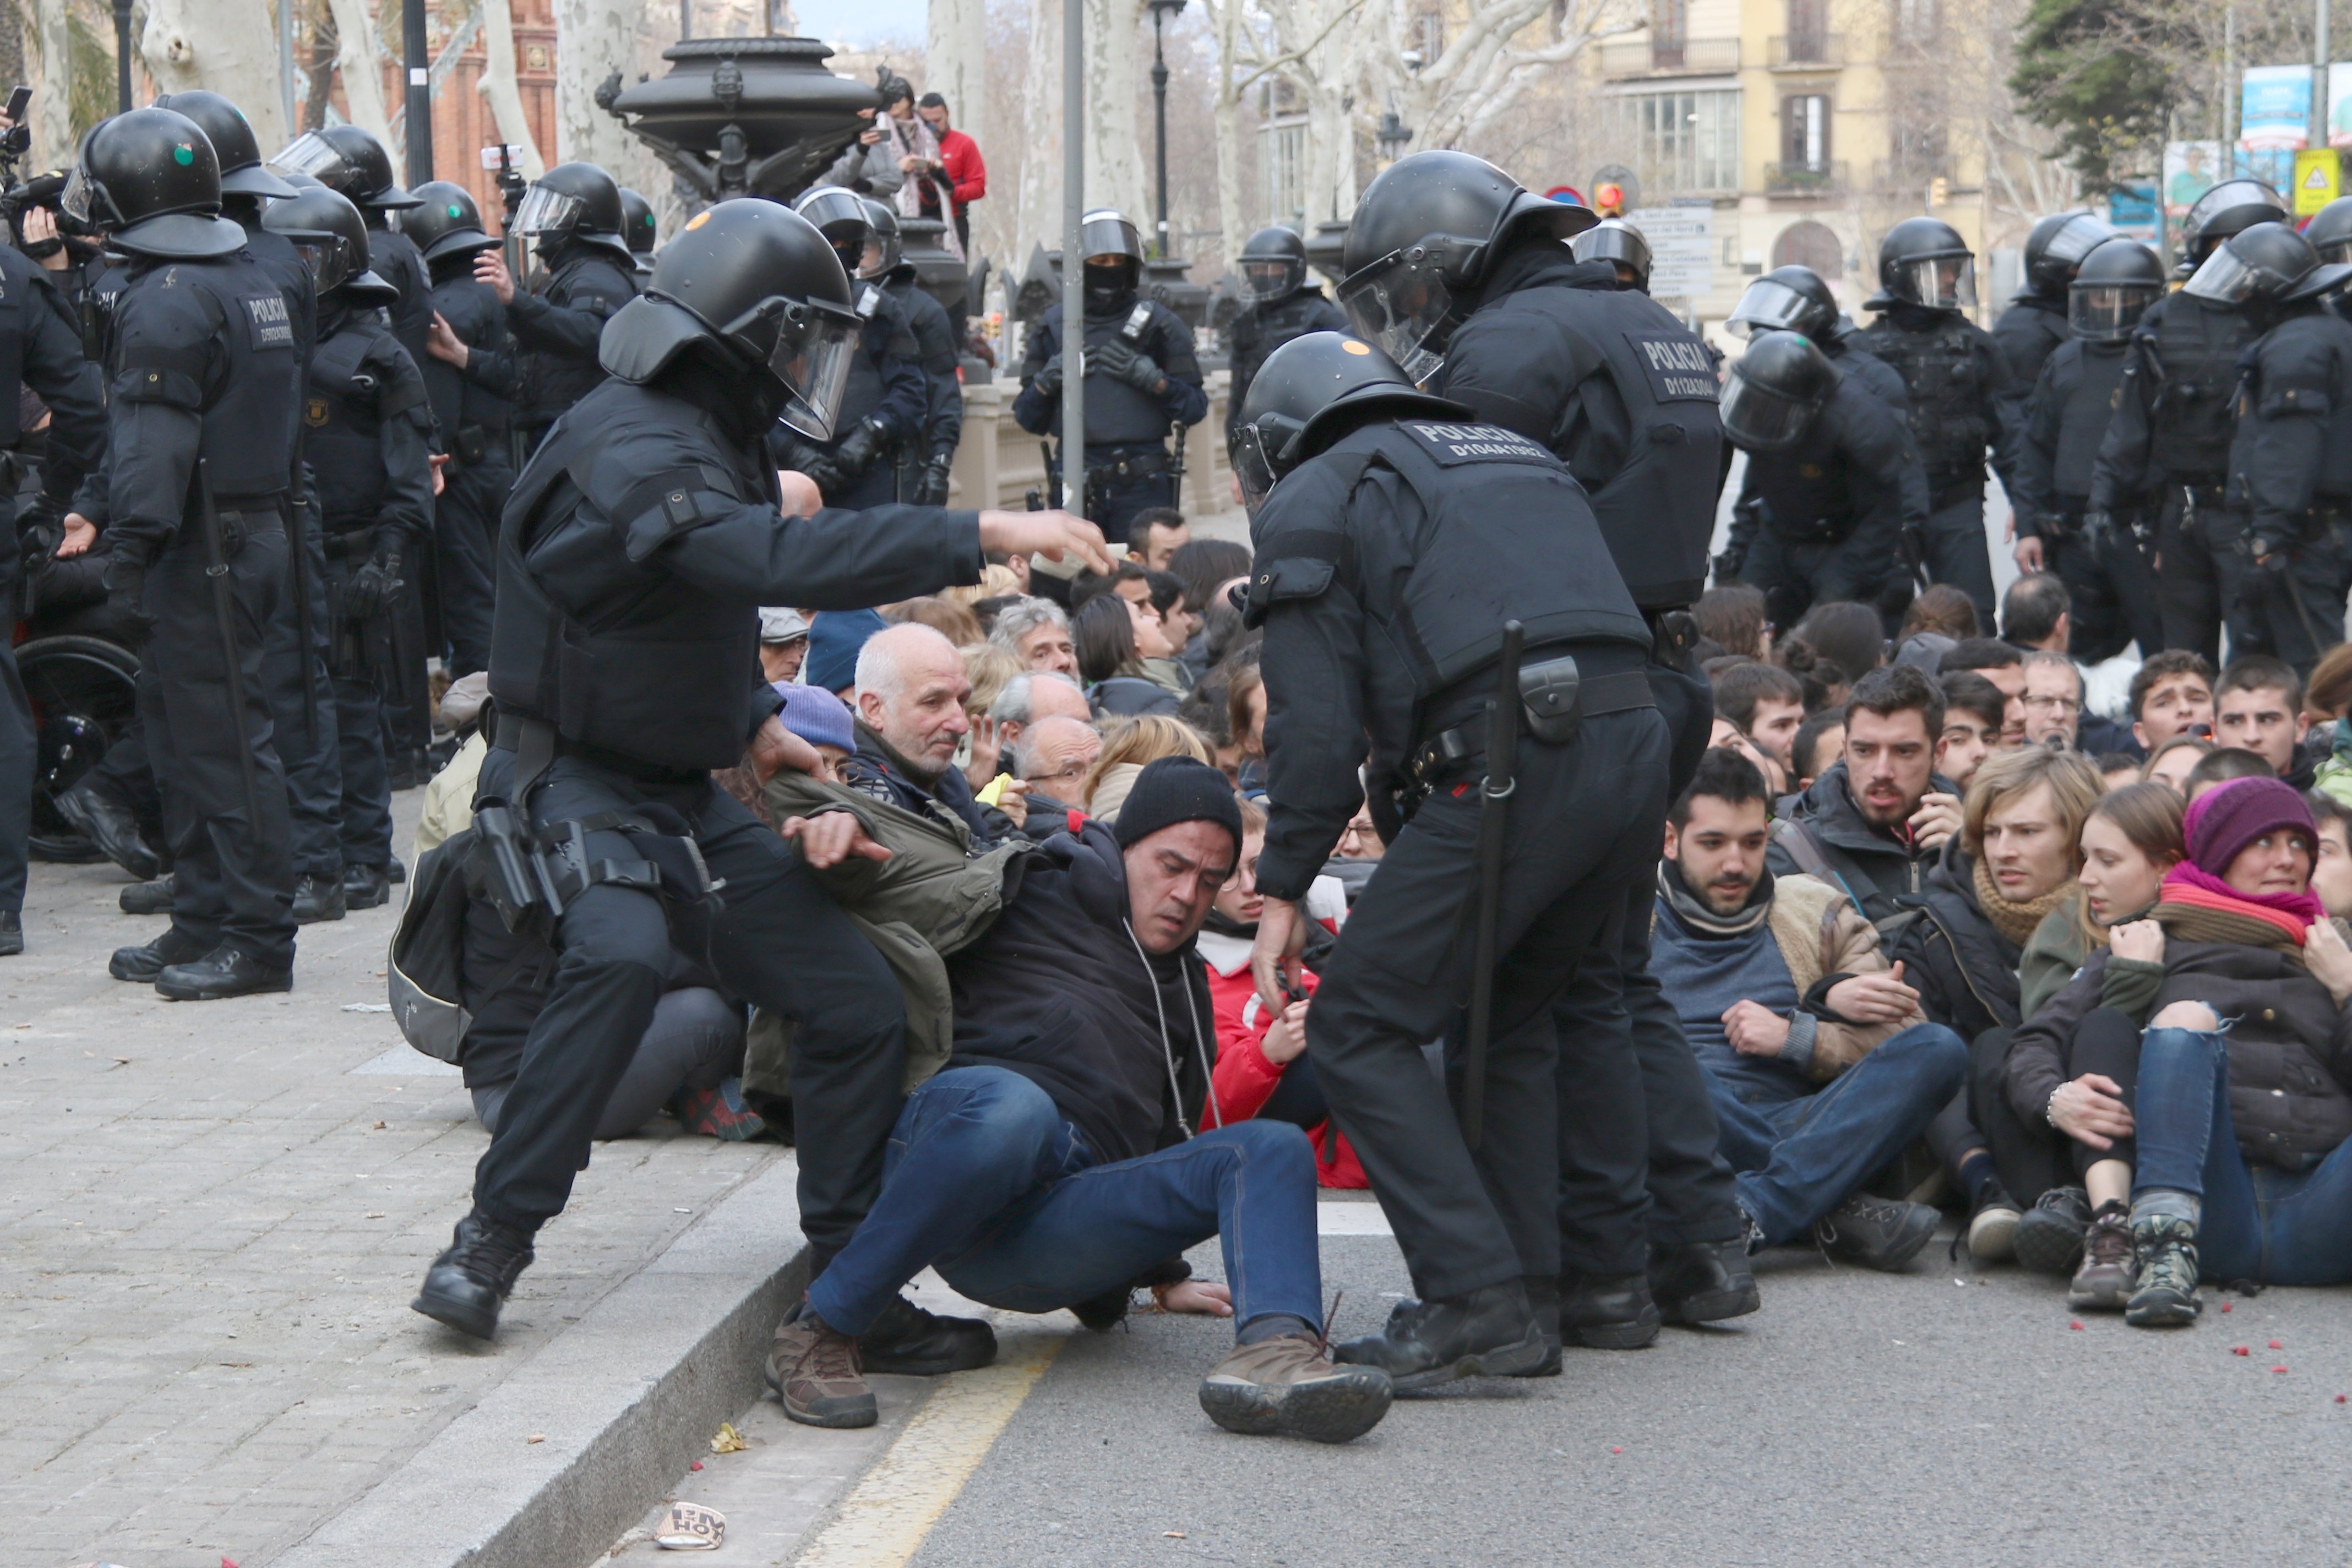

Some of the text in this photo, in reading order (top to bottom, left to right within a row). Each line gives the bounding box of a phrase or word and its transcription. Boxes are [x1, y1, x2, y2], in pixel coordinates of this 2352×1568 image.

[249, 297, 289, 324] POLICIA
[1642, 341, 1710, 373] POLICIA
[1413, 424, 1531, 445] POLICIA
